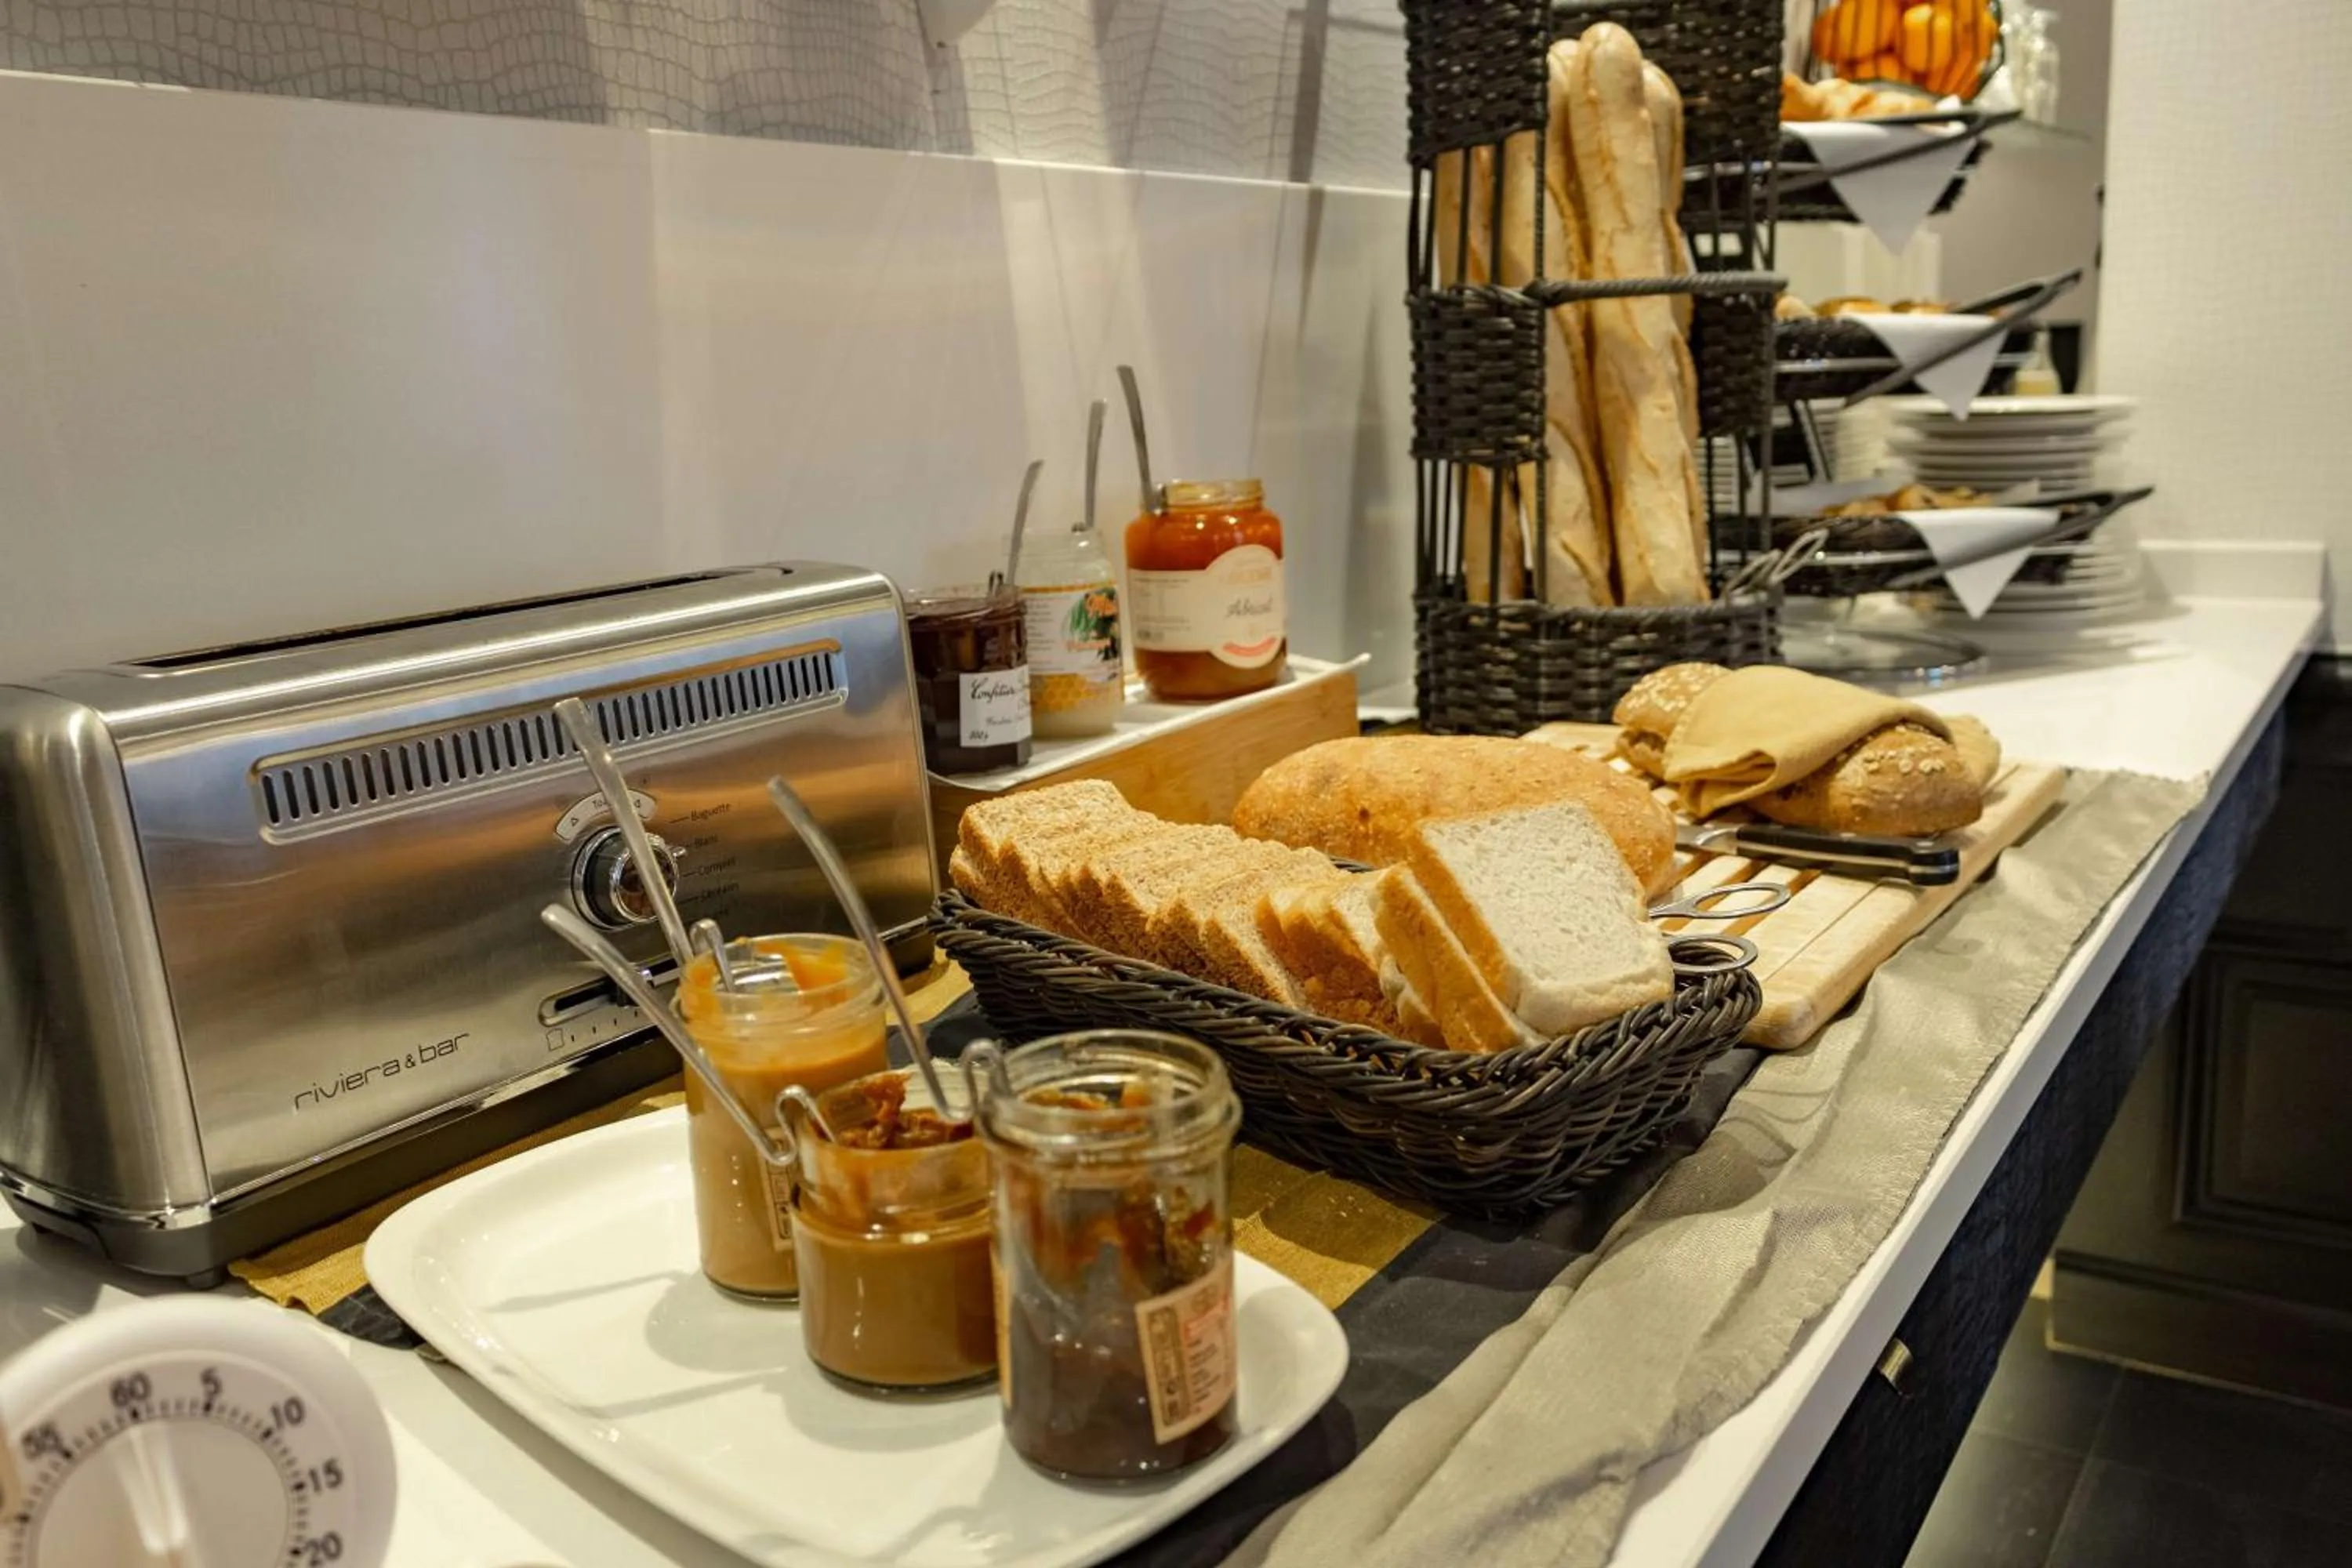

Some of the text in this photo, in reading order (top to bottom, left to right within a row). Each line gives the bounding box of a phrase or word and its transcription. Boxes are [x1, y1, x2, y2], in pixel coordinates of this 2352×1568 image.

[111, 1371, 151, 1408] 60
[200, 1368, 223, 1399] 5
[270, 1396, 307, 1429] 10
[308, 1458, 344, 1494] 15
[306, 1532, 343, 1568] 20
